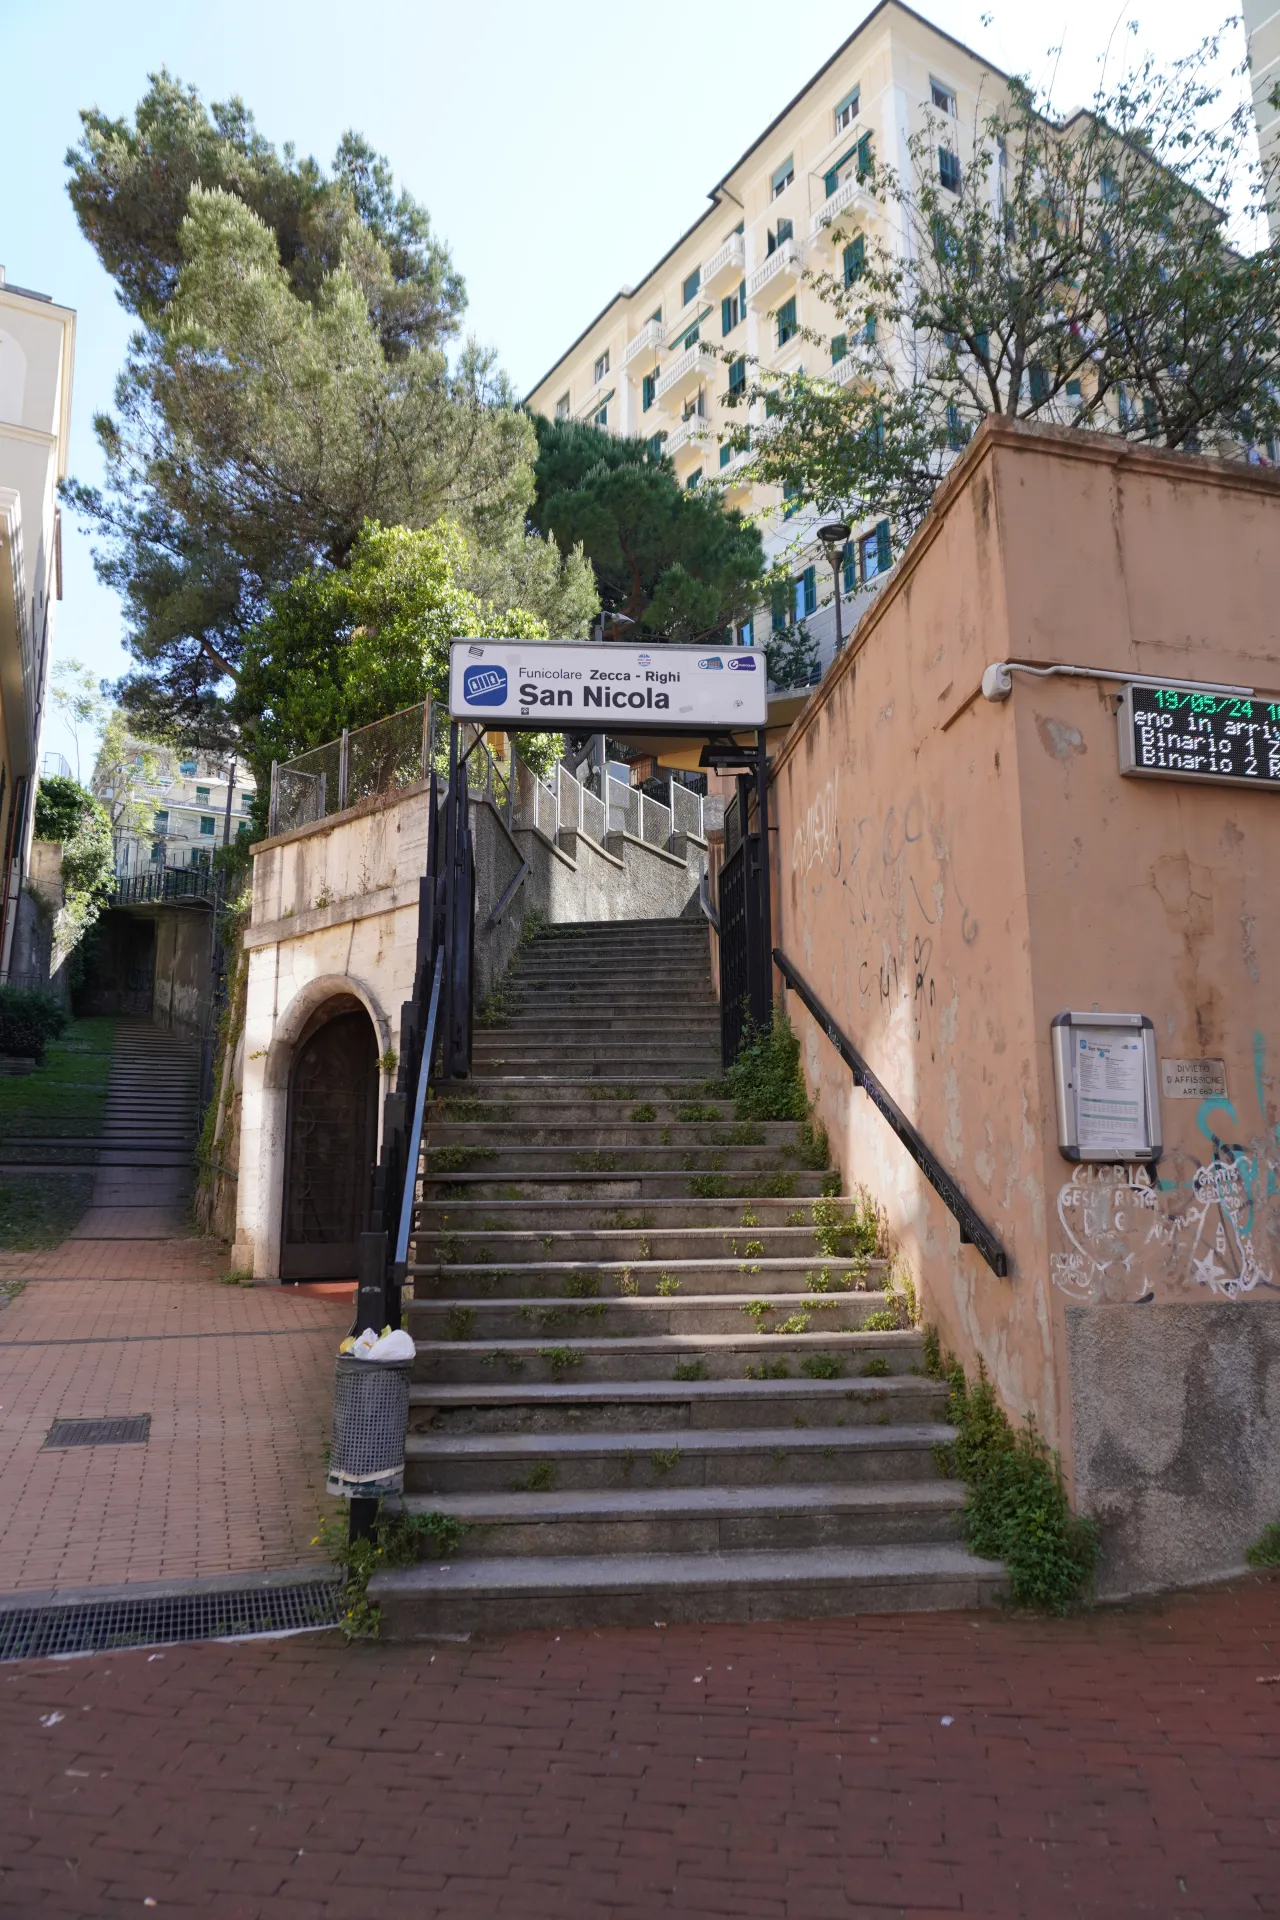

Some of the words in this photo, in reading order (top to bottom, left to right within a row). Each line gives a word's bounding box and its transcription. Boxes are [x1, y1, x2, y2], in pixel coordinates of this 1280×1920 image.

[518, 667, 582, 681] Funicolare
[590, 669, 631, 682] Zecca
[645, 670, 681, 685] Righi
[518, 683, 573, 707] San
[583, 685, 670, 710] Nicola
[1188, 712, 1212, 732] in
[1141, 726, 1232, 753] Binario
[1245, 738, 1255, 756] 1
[1142, 746, 1233, 773] Binario
[1244, 756, 1258, 775] 2
[1177, 1064, 1210, 1073] DIVIETO
